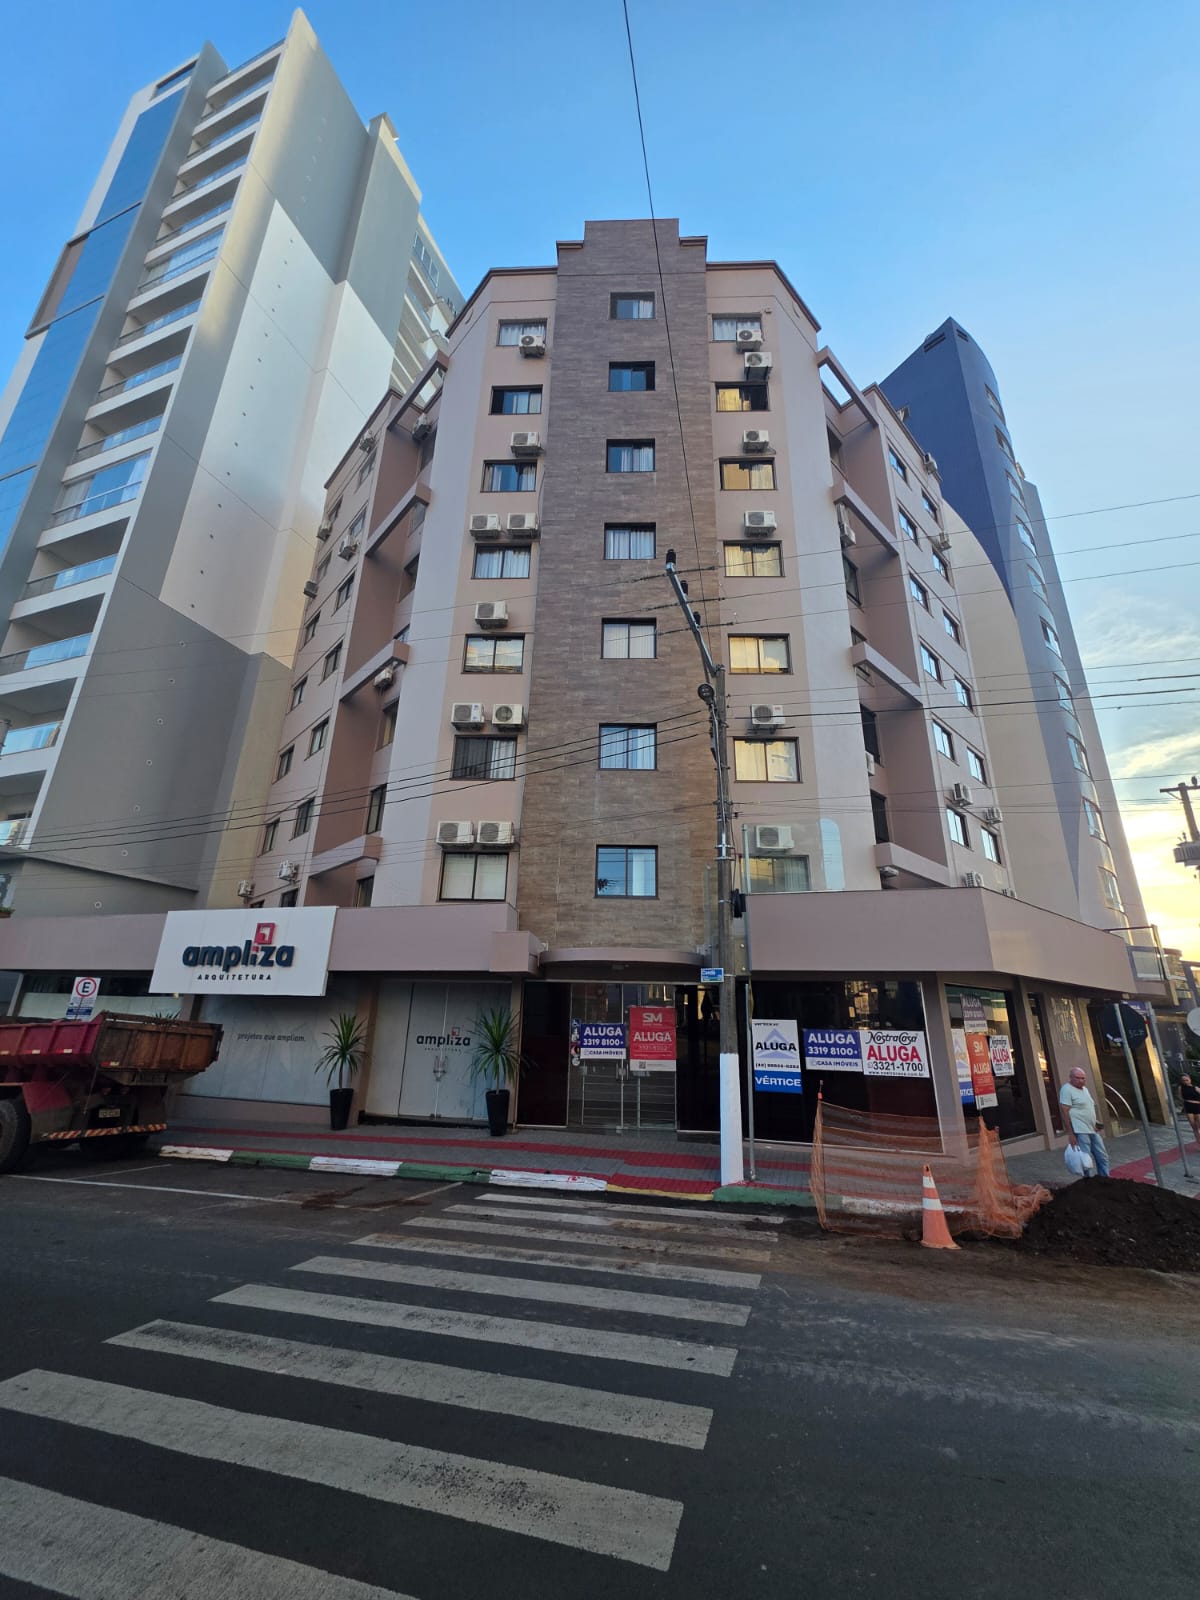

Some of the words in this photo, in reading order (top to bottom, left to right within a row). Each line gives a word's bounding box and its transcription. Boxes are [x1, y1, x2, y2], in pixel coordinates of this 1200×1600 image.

[182, 939, 295, 973] ampliza
[82, 981, 91, 993] E
[584, 1026, 623, 1037] ALUGA
[633, 1031, 672, 1042] ALUGA
[416, 1034, 471, 1047] ampliza
[583, 1038, 600, 1046] 3319
[601, 1038, 620, 1046] 8100
[808, 1032, 856, 1045] ALUGA
[755, 1041, 797, 1052] ALUGA
[808, 1046, 829, 1055] 3319
[830, 1047, 853, 1056] 8100
[867, 1044, 922, 1062] ALUGA
[873, 1061, 924, 1072] 3321-1700
[755, 1074, 802, 1087] VÉRTICE
